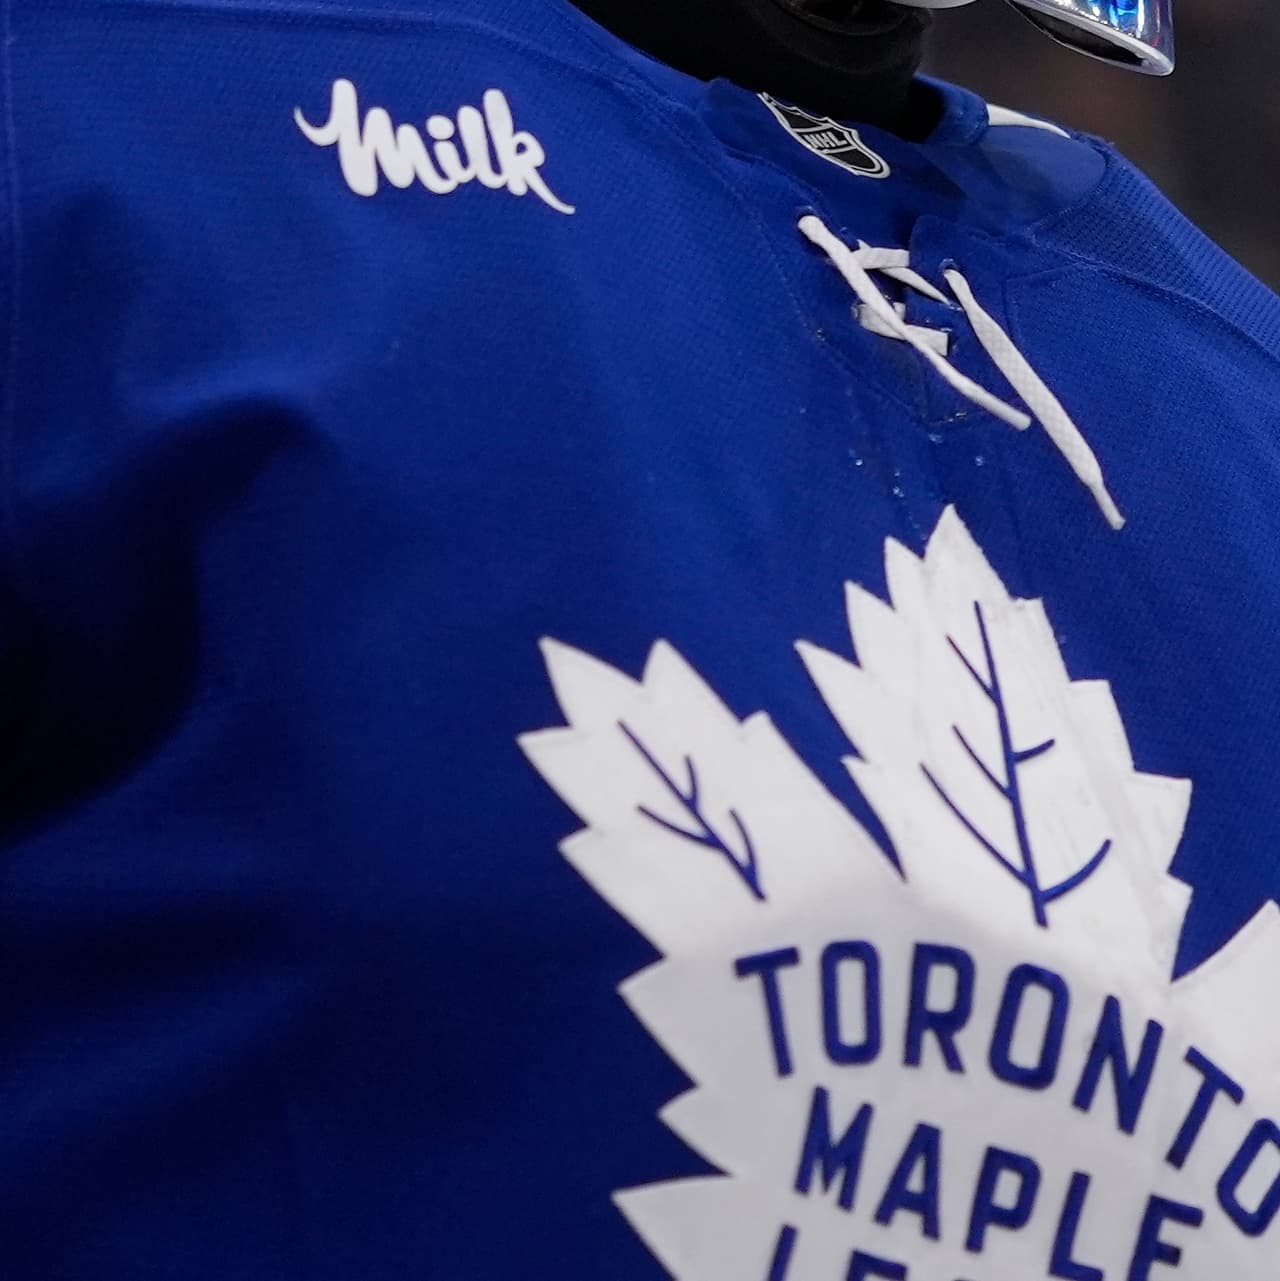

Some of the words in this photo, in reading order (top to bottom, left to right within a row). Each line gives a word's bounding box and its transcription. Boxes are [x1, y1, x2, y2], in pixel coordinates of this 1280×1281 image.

[293, 78, 576, 215] Milk
[802, 130, 847, 149] NHL
[795, 1084, 1203, 1281] MAPLE
